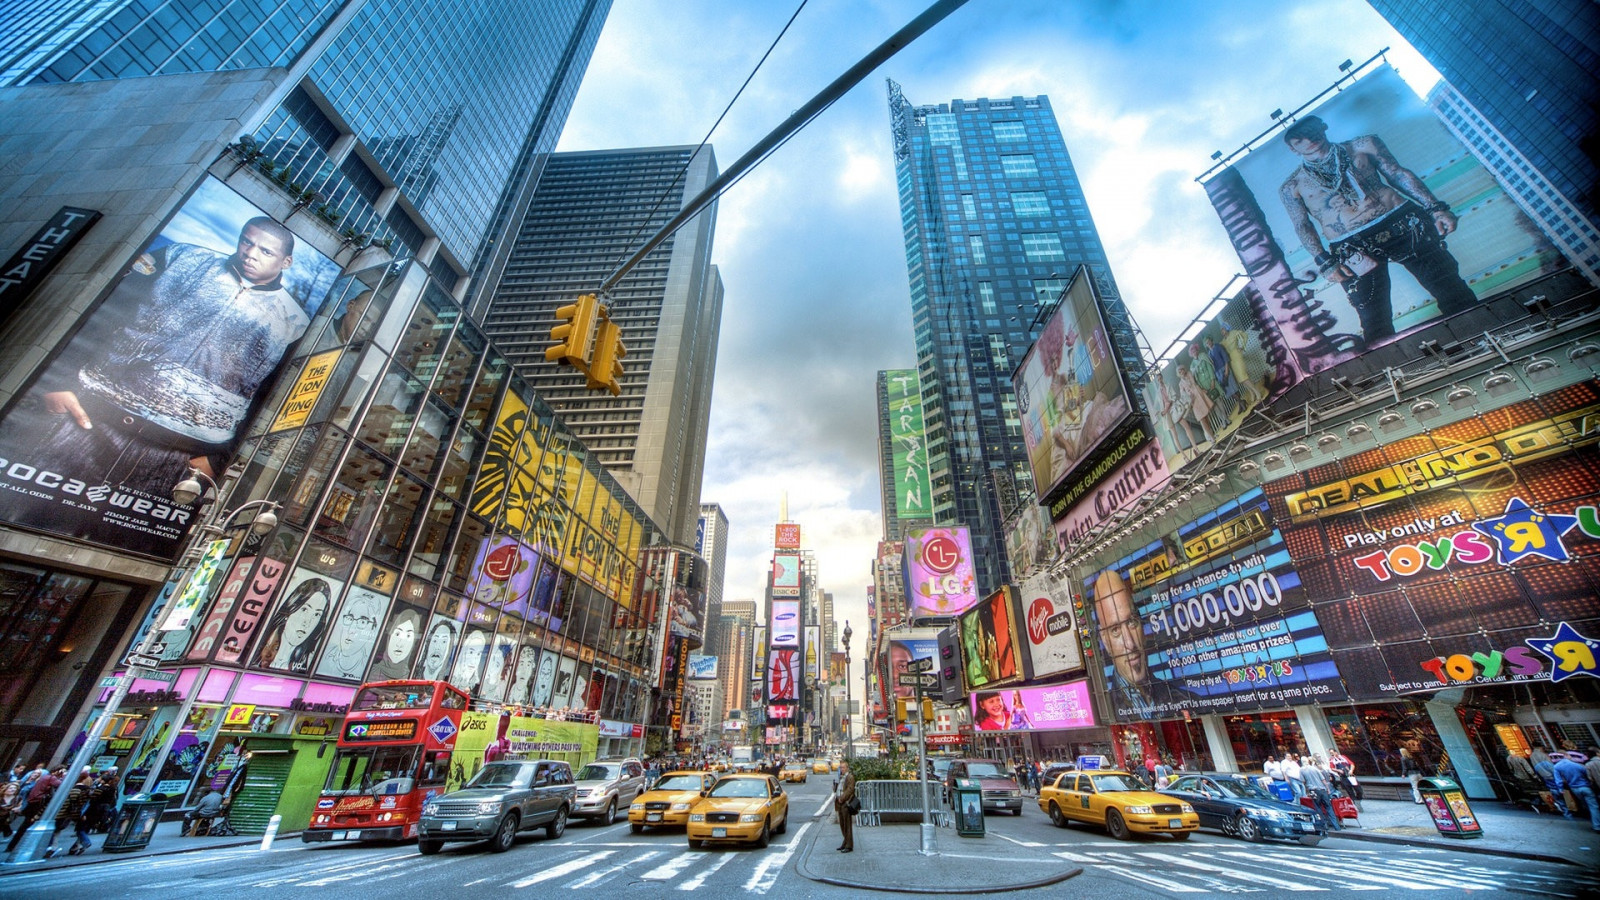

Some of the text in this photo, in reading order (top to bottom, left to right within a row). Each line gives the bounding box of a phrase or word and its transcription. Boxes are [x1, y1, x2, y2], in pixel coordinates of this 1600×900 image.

[307, 364, 329, 378] THE
[292, 379, 323, 400] LION
[280, 398, 313, 421] KING
[1051, 427, 1146, 518] BORN IN THE GLAMOROUS USA
[1094, 445, 1164, 520] Couture
[1294, 476, 1403, 517] DEAL
[1402, 459, 1432, 493] OR
[9, 485, 28, 495] ALL
[29, 490, 54, 501] ODDS
[61, 499, 76, 508] DR.
[104, 510, 131, 522] JIMMY
[130, 517, 149, 527] JAZZ
[119, 485, 133, 494] WE
[132, 489, 152, 499] RUN
[152, 495, 171, 505] THE
[1343, 509, 1466, 549] Play only at
[320, 553, 336, 566] we
[1353, 531, 1494, 583] TOYS
[928, 575, 961, 597] LG
[1151, 591, 1169, 605] Play
[1169, 586, 1183, 597] for
[1192, 570, 1228, 589] chance
[1229, 562, 1242, 573] to
[1243, 554, 1267, 570] win
[194, 561, 252, 652] PEACE
[223, 562, 281, 654] PEACE
[474, 611, 492, 623] speak
[1149, 571, 1283, 641] $1,000,000
[1048, 616, 1070, 633] mobile
[1166, 647, 1174, 656] or
[1180, 642, 1194, 656] trip
[1194, 639, 1204, 649] to
[1204, 636, 1218, 647] the
[1219, 629, 1247, 644] show,
[1246, 627, 1257, 637] or
[1259, 621, 1281, 633] over
[144, 658, 155, 666] WAY
[678, 638, 689, 676] KODAK
[1167, 633, 1293, 669] 100,000 other amazing prizes!
[1420, 646, 1544, 684] TOYS
[1186, 678, 1201, 689] Play
[1200, 676, 1215, 687] only
[1214, 675, 1223, 684] at
[1222, 666, 1256, 685] TOYS
[1271, 659, 1292, 677] US
[1378, 682, 1412, 692] Subject
[1411, 681, 1423, 690] to
[1198, 695, 1235, 708] newspaper
[1234, 692, 1256, 703] insert
[1256, 690, 1269, 701] for
[1269, 691, 1277, 700] a
[1276, 687, 1302, 701] game
[1302, 683, 1333, 699] piece.
[511, 742, 582, 752] WATCHING OTHERS PASS YOU
